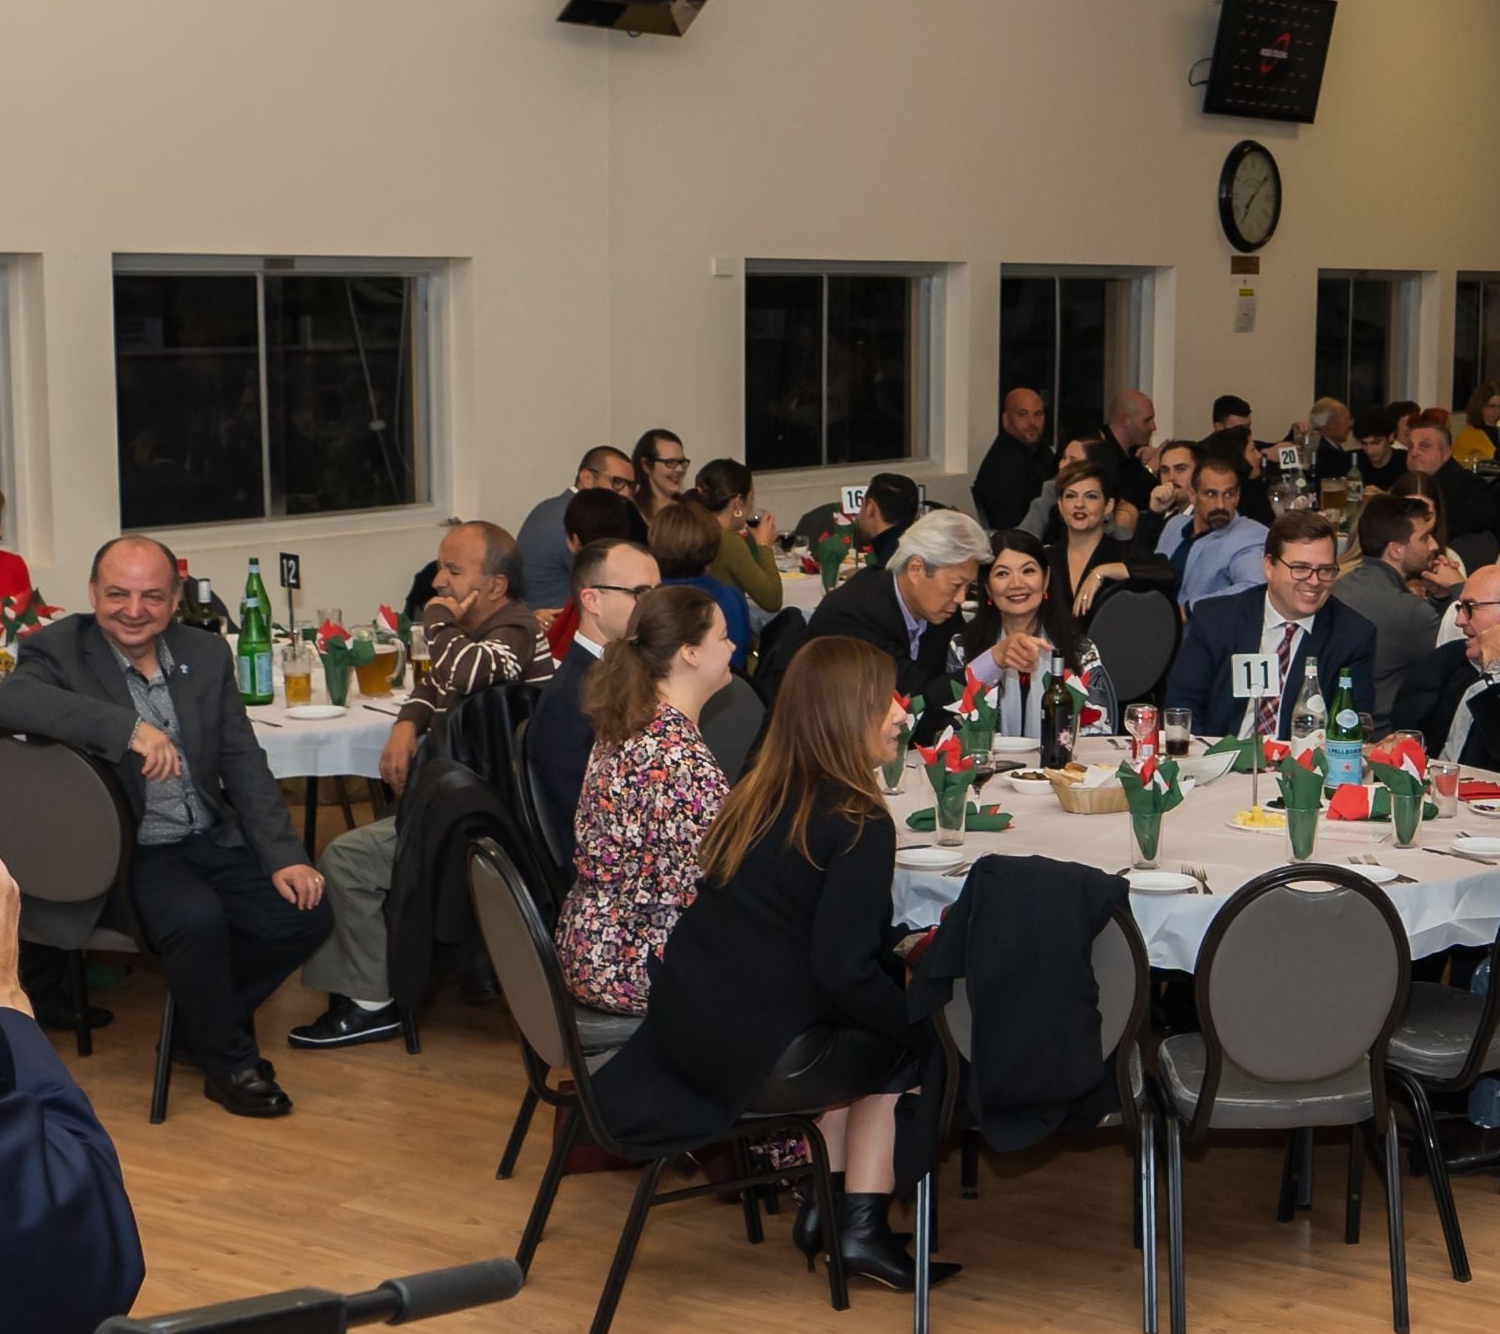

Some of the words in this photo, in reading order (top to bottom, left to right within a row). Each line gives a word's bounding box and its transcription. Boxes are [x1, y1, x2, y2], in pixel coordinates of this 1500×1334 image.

[1281, 449, 1296, 465] 20
[847, 490, 863, 508] 16
[282, 558, 297, 586] 12
[1243, 661, 1269, 690] 11
